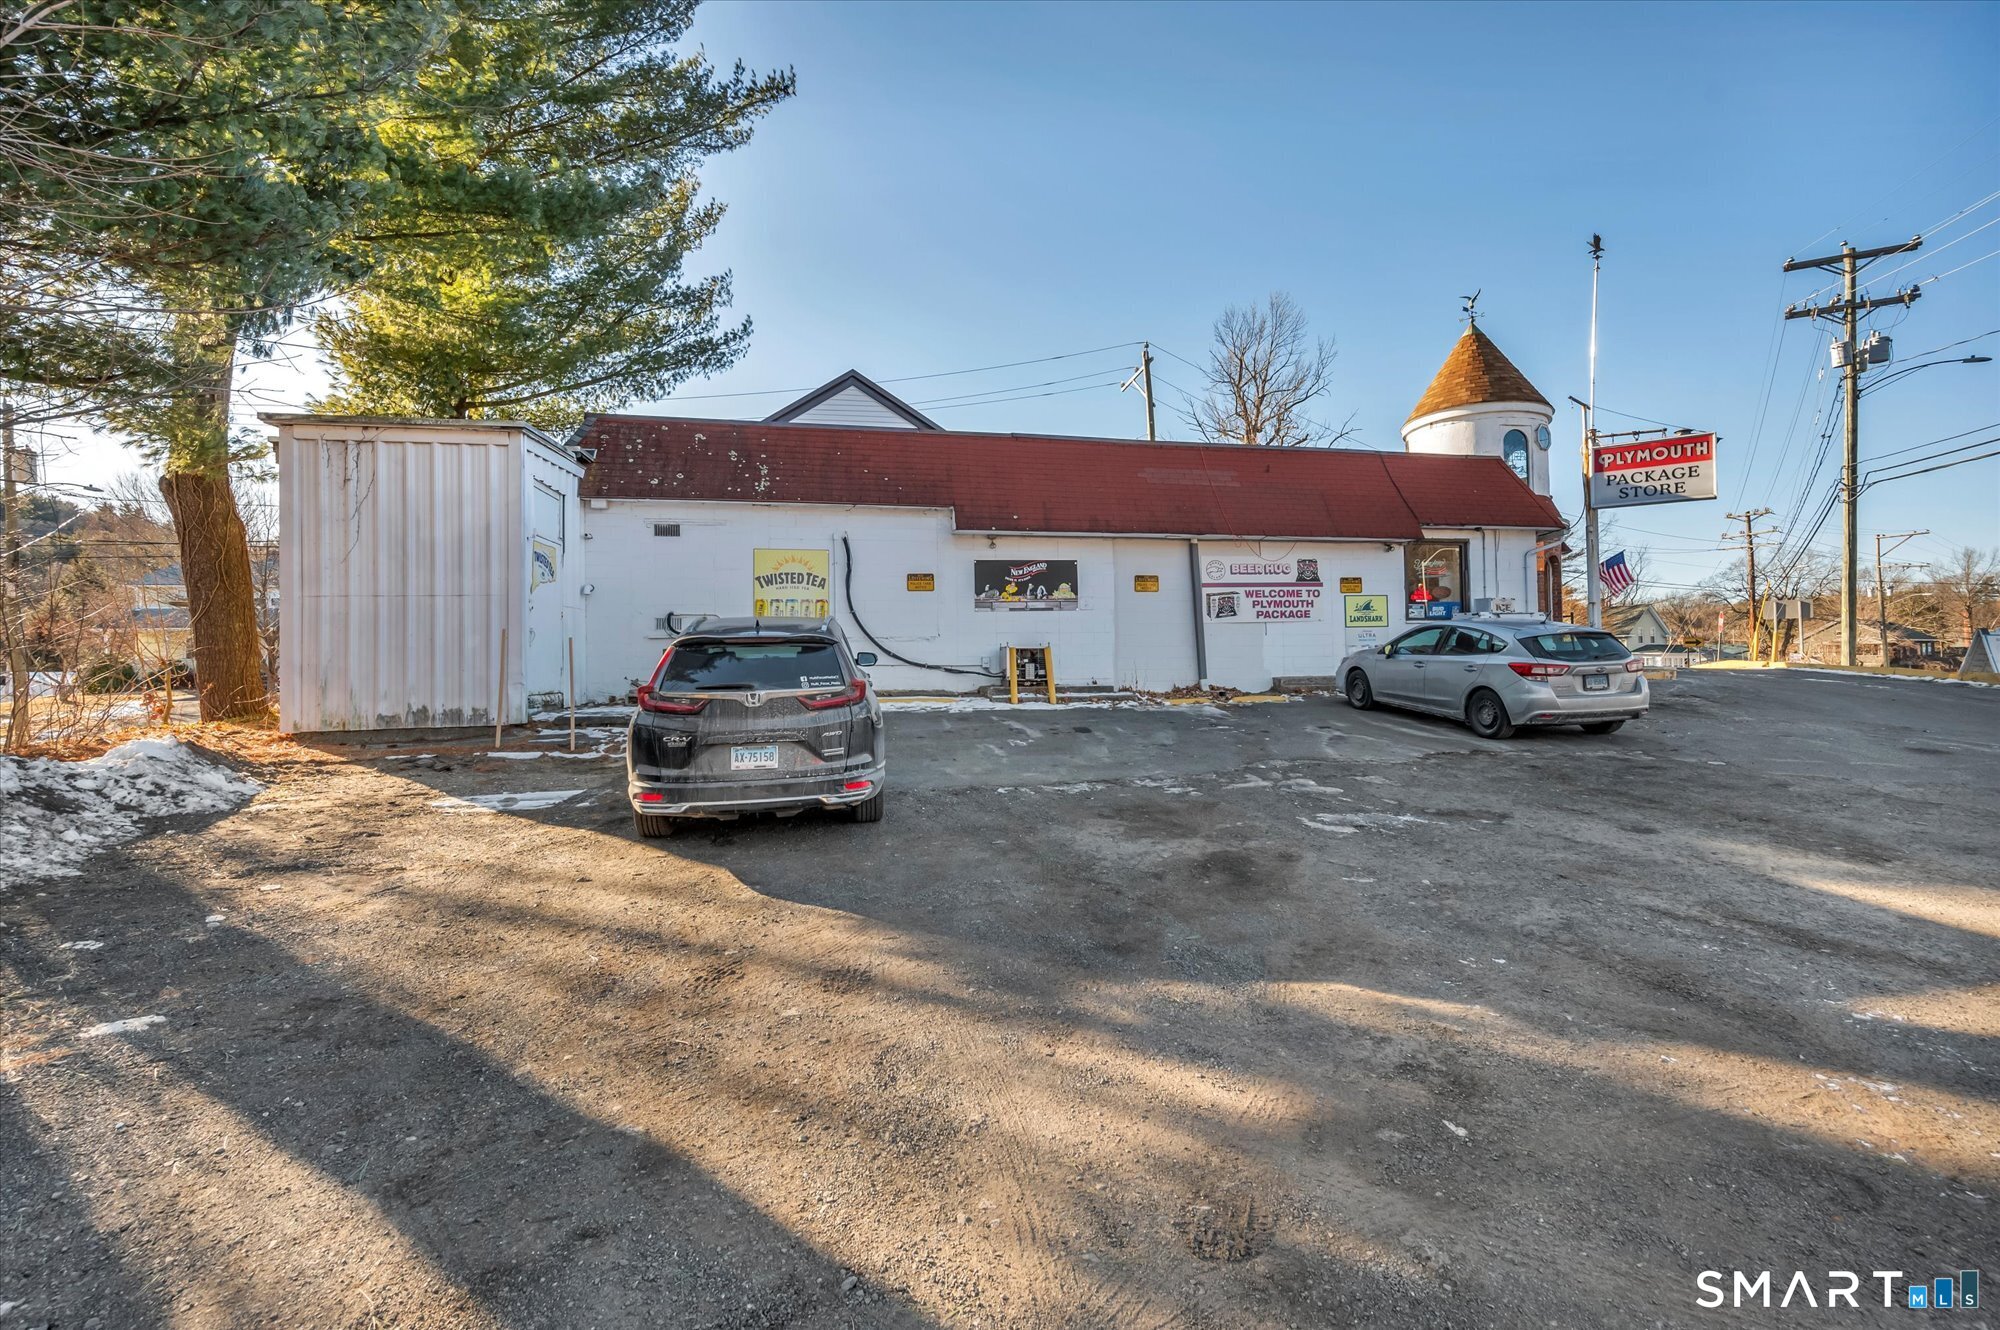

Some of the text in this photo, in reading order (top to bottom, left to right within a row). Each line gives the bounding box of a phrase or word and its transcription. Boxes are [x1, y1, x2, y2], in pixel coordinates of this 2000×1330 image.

[1598, 441, 1709, 468] PLYMOUTH
[1606, 465, 1700, 486] PACKAGE
[1618, 482, 1686, 499] STORE
[1010, 562, 1048, 576] NEW ENGLAND
[1230, 563, 1292, 575] BEER HUG
[755, 572, 827, 590] TWISTED TEA
[1244, 589, 1321, 598] WELCOME TO
[1252, 600, 1314, 608] PLYMOUTH
[1495, 604, 1511, 612] ICE
[1256, 610, 1311, 619] PACKAGE
[1349, 615, 1383, 623] LANDSHARK
[734, 752, 774, 763] AX-75158
